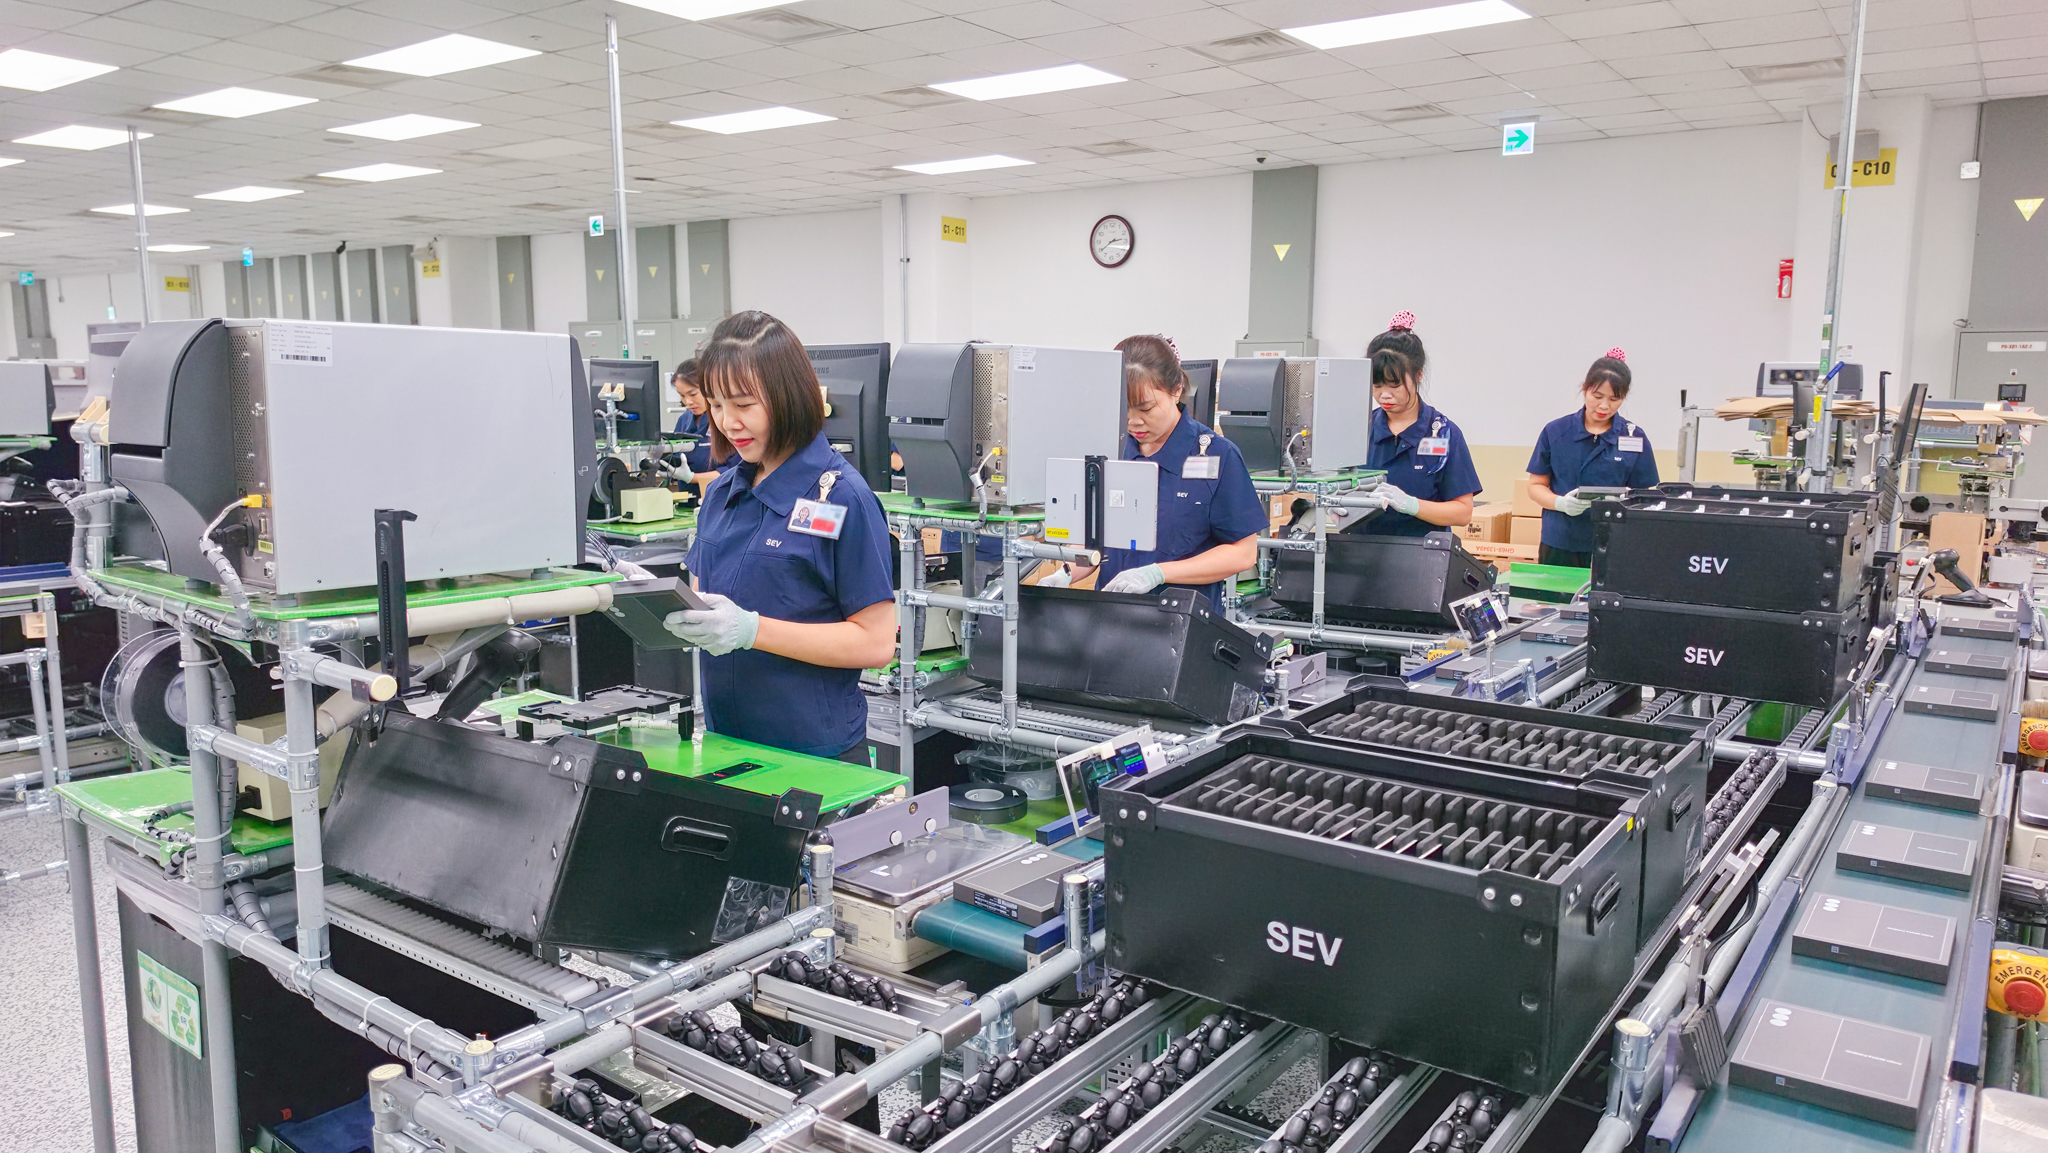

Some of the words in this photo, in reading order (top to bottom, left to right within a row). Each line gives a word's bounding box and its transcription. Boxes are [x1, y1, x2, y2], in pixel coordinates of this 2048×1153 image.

[1863, 161, 1890, 176] C10
[765, 538, 783, 548] SEV
[1688, 555, 1729, 575] SEV
[1684, 646, 1725, 667] SEV
[1266, 920, 1343, 967] SEV
